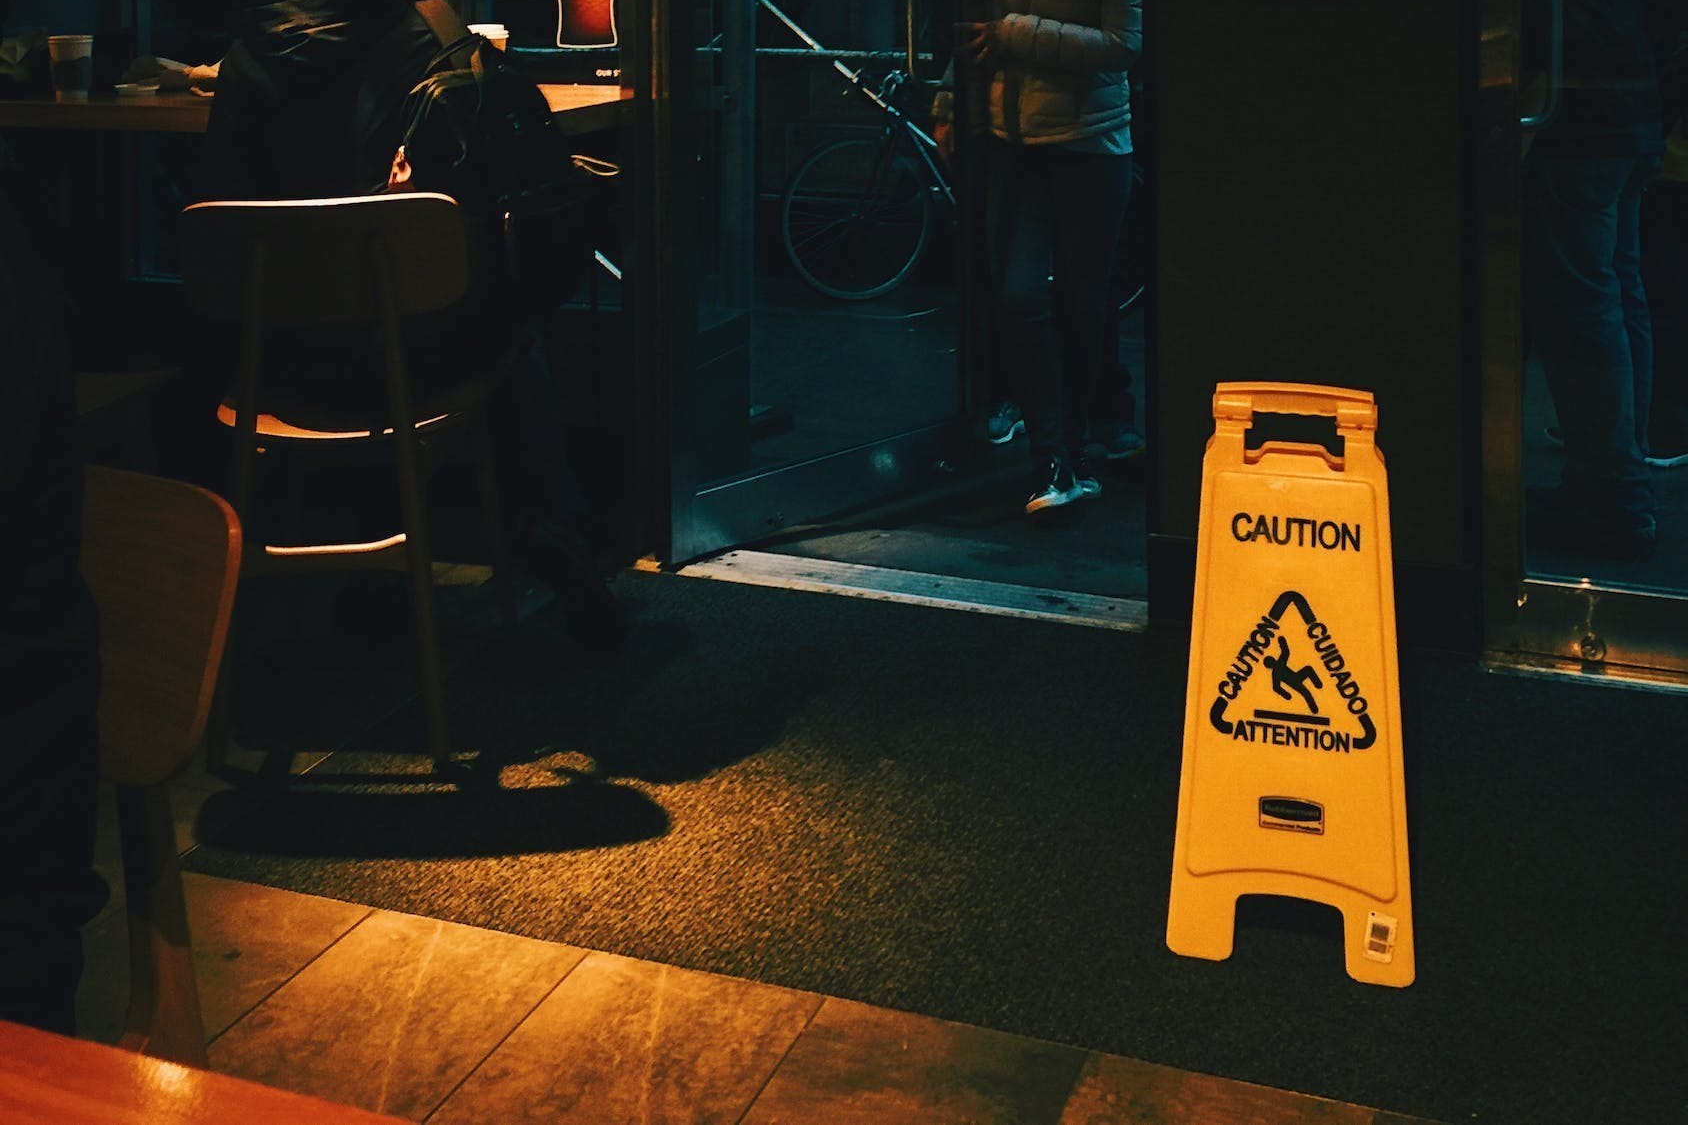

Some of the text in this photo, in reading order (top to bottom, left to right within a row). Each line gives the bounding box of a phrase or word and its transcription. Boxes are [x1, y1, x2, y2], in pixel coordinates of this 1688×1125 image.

[1231, 512, 1361, 552] CAUTION
[1218, 615, 1280, 700] CAUTION
[1307, 622, 1368, 715] CUIDADO
[1233, 720, 1350, 753] ATTENTION
